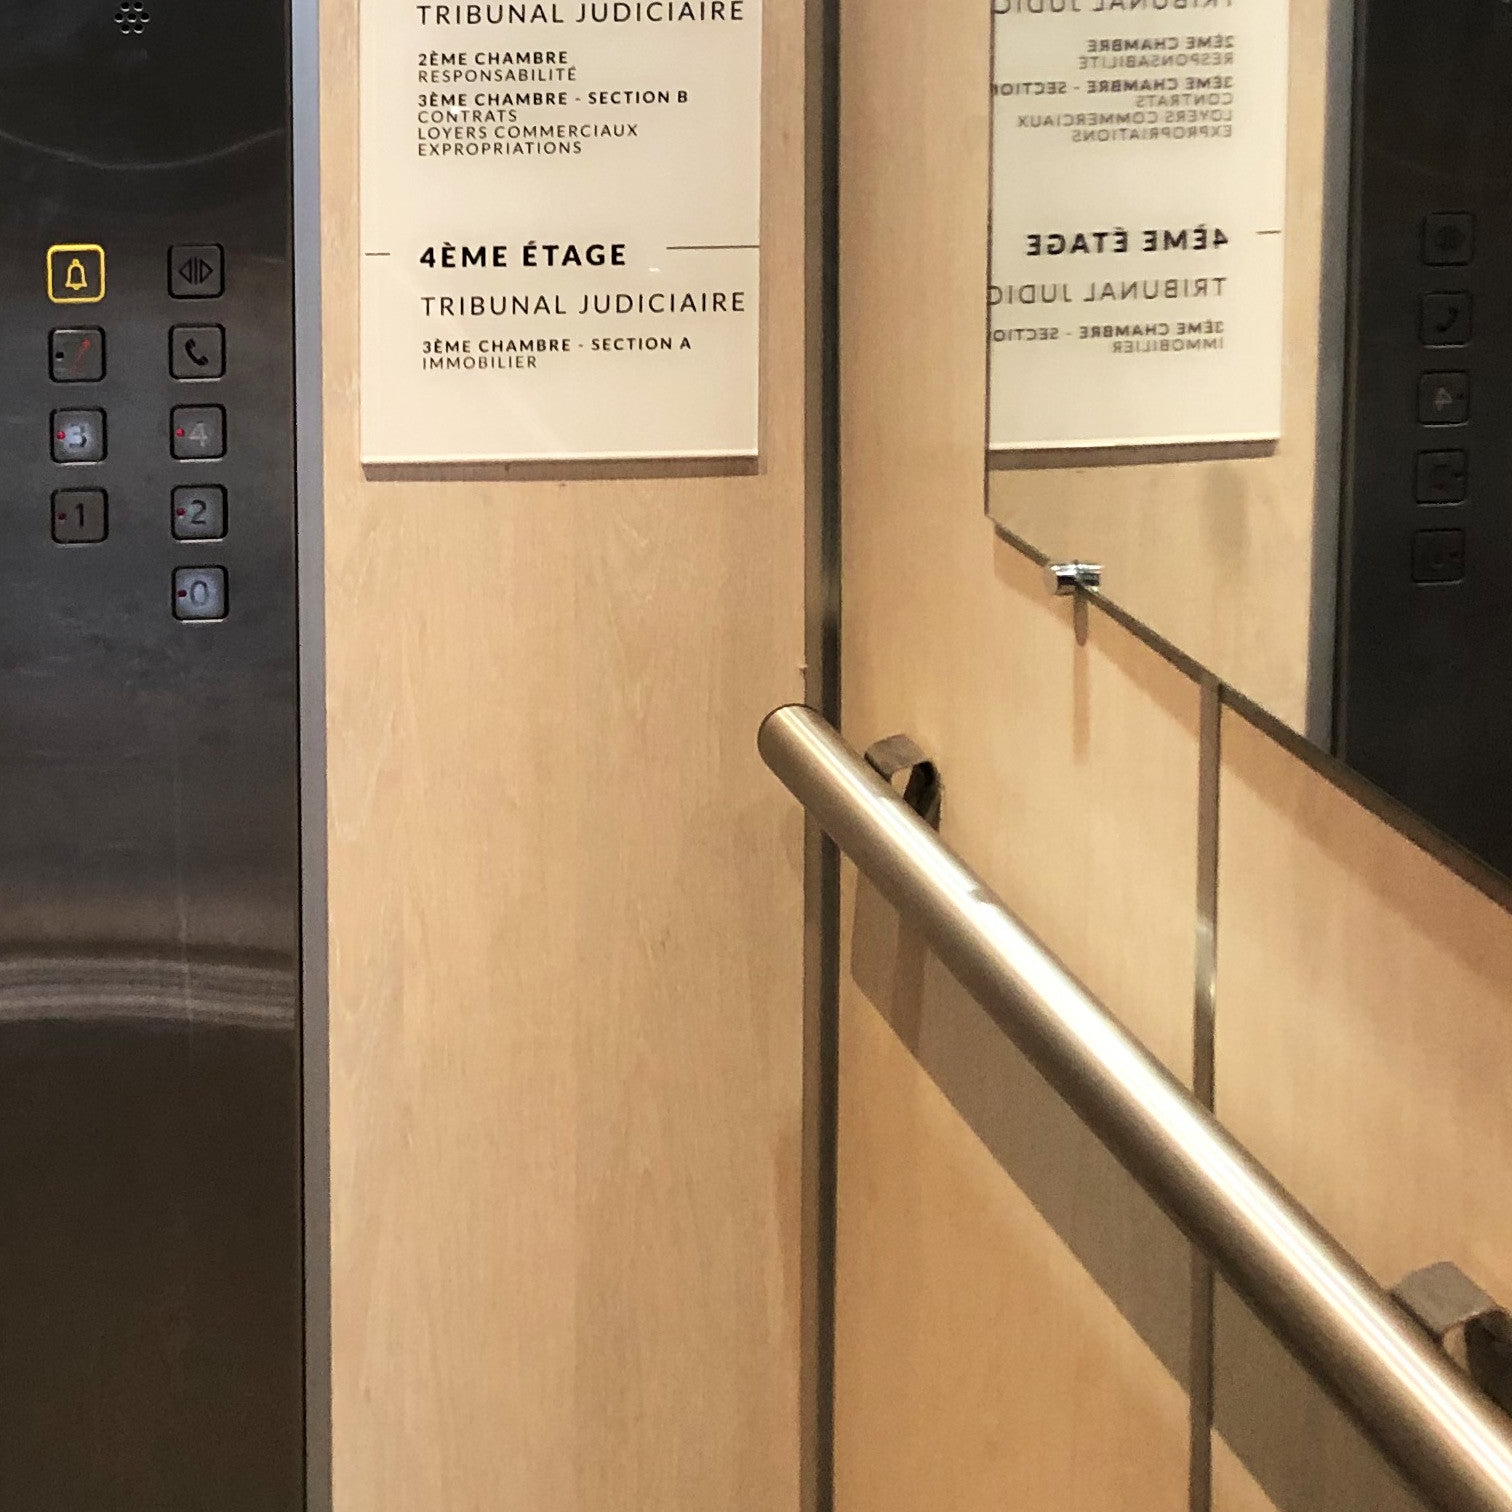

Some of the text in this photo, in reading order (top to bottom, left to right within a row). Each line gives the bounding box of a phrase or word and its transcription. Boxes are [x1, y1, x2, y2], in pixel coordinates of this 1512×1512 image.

[417, 0, 744, 25] TRIBUNAL JUDICIAIRE
[418, 50, 568, 66] 2ÈME CHAMBRE
[418, 65, 577, 83] RESPONSABILITÉ
[418, 92, 467, 107] 3ÈME
[475, 92, 567, 106] CHAMBRE
[588, 90, 669, 105] SECTION
[677, 90, 688, 103] B
[417, 109, 517, 124] CONTRATS
[418, 124, 638, 139] LOYERS COMMERCIAUX
[418, 141, 582, 156] EXPROPRIATIONS
[420, 240, 626, 268] 4ÈME ÉTAGE
[421, 292, 745, 316] TRIBUNAL JUDICIAIRE
[422, 338, 471, 354] 3ÈME
[478, 338, 571, 353] CHAMBRE
[591, 337, 673, 351] SECTION
[680, 337, 692, 350] A
[422, 355, 537, 370] IMMOBILIER
[67, 425, 88, 449] 3
[189, 422, 208, 447] 4
[75, 503, 85, 527] 1
[191, 500, 207, 524] 2
[190, 581, 209, 606] 0
